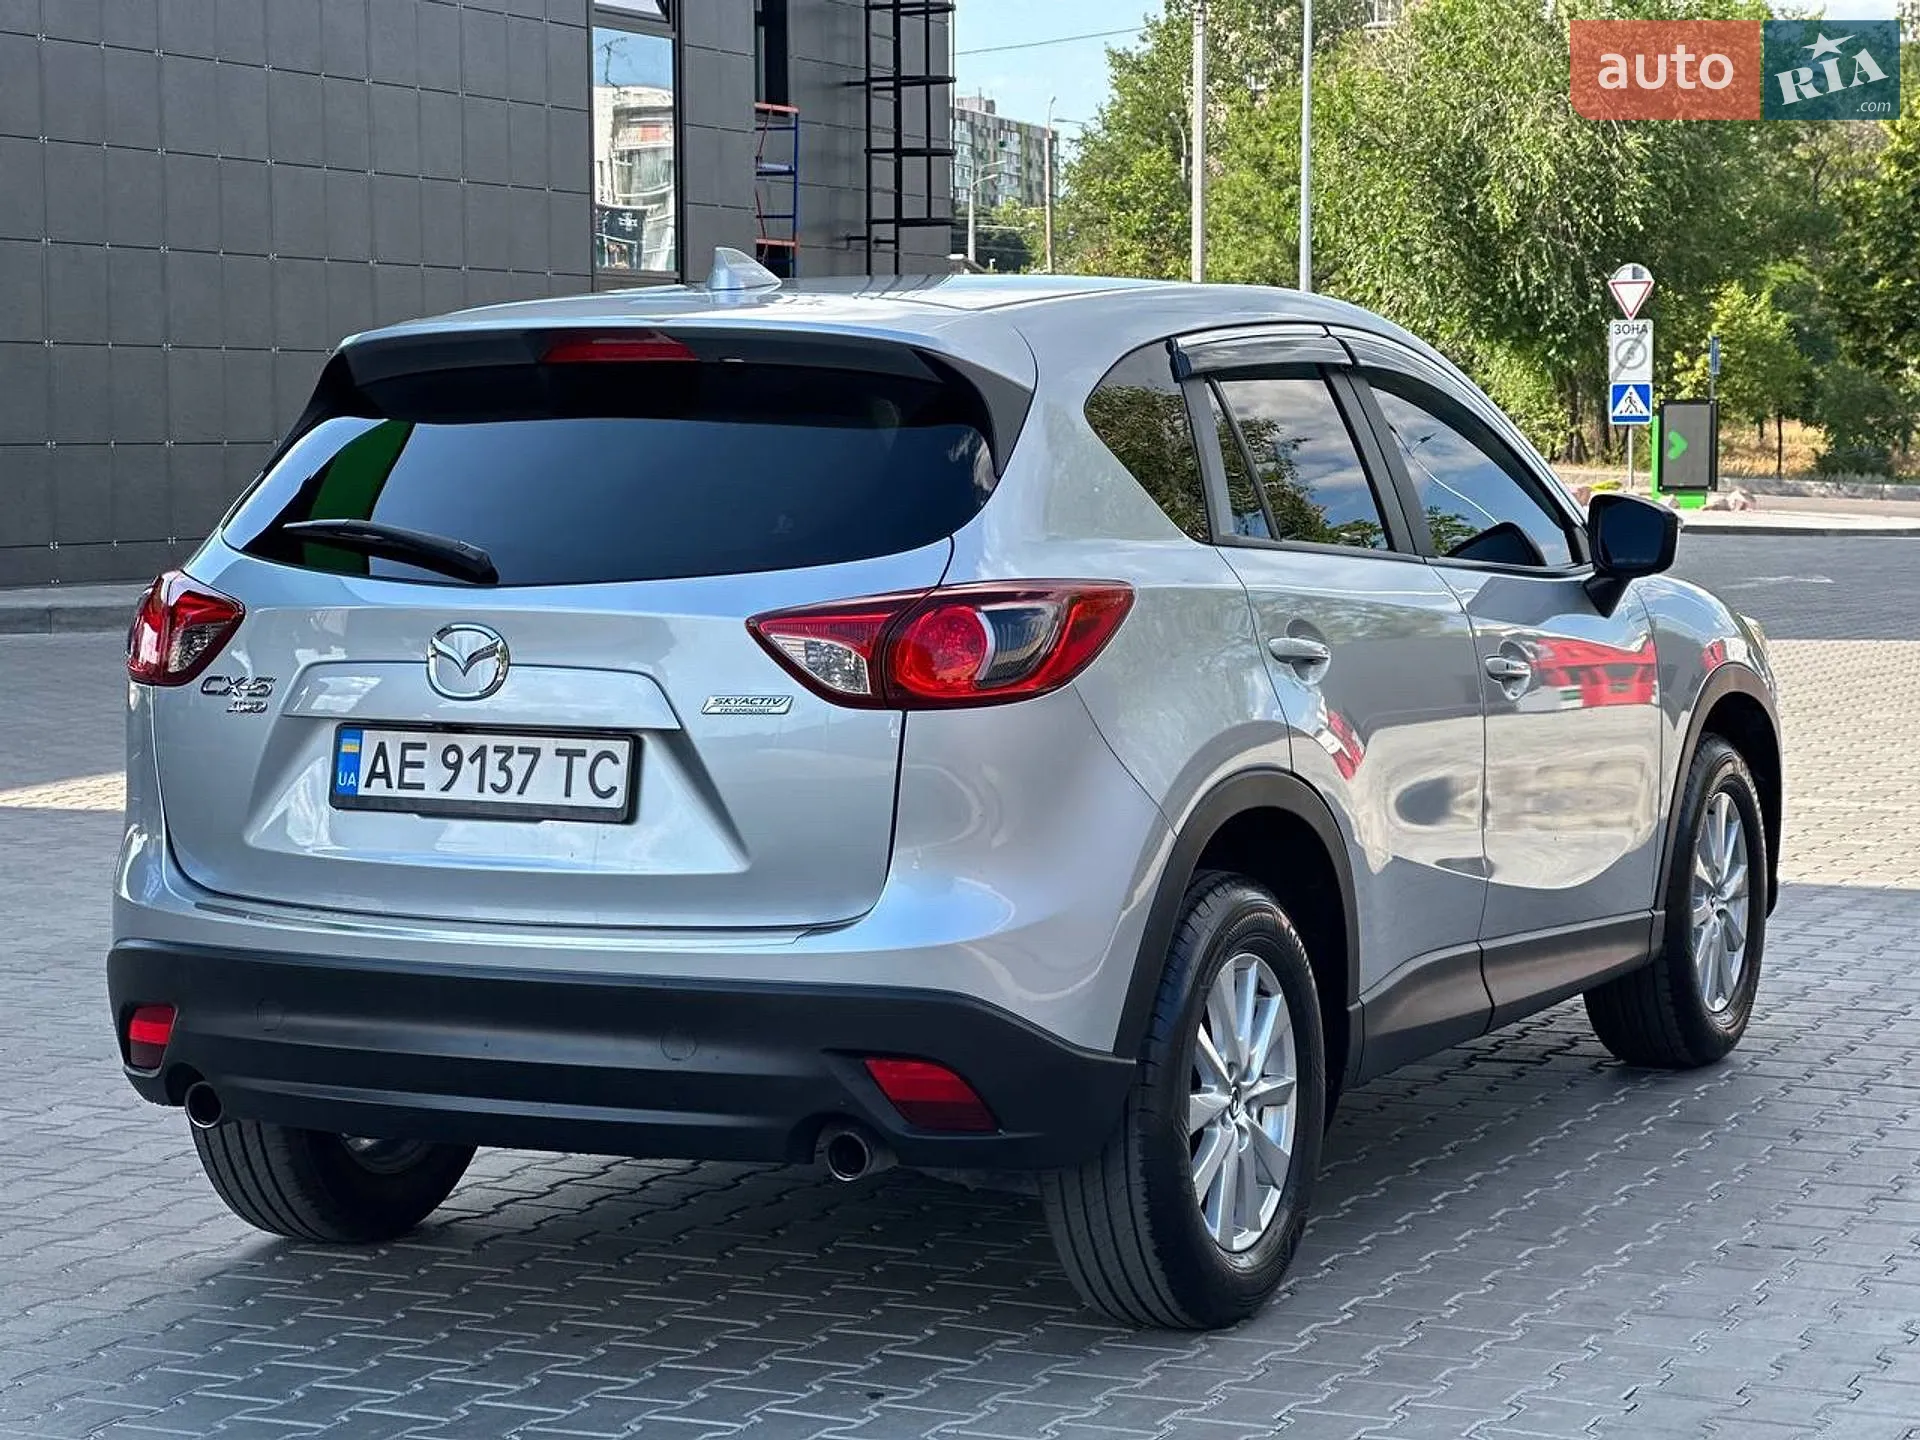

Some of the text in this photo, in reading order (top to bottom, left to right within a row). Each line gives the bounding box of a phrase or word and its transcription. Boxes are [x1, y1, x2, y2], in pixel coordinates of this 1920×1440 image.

[1614, 323, 1648, 335] ЗОНА
[714, 697, 784, 705] SKYACTIV
[364, 741, 620, 799] AE 9137 TC
[338, 772, 357, 787] UA
